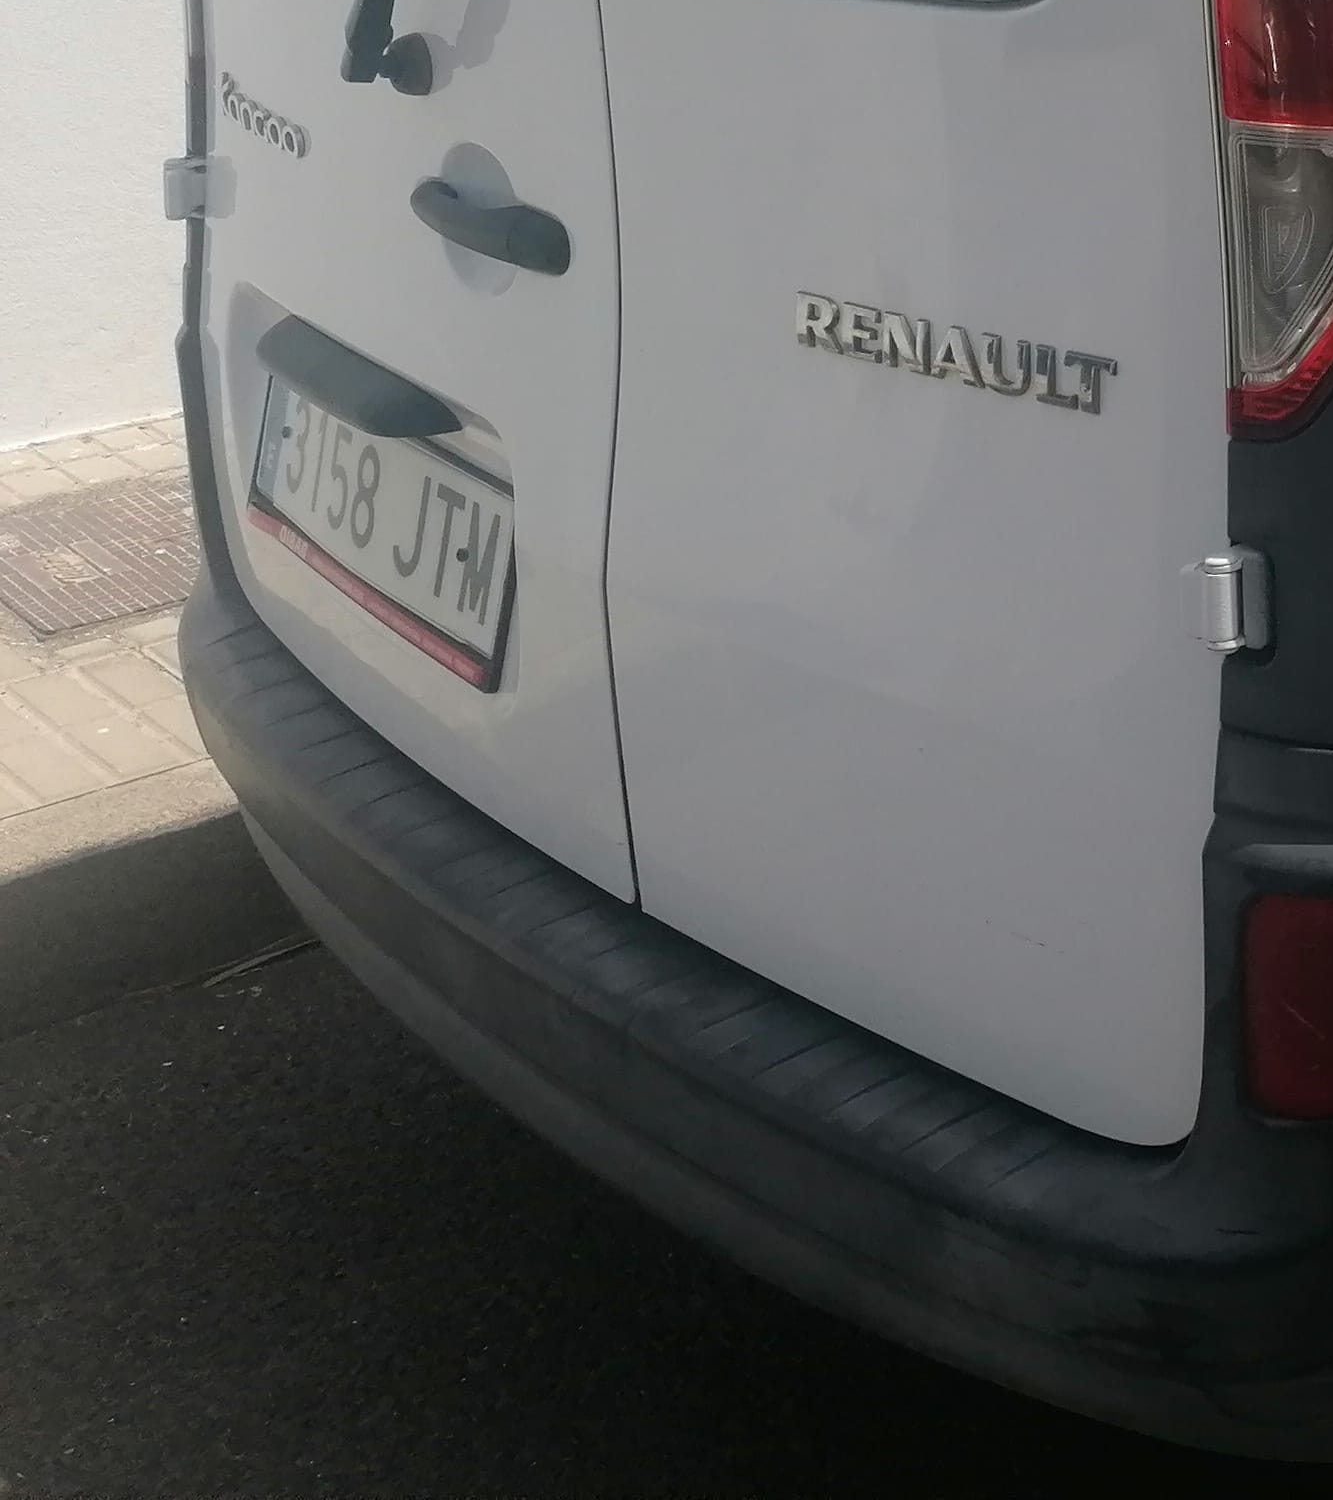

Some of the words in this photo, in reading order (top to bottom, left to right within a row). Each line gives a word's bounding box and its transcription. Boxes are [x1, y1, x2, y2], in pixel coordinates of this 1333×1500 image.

[796, 290, 1118, 415] RENAULT
[286, 401, 380, 549] 3158
[393, 475, 501, 626] JTM
